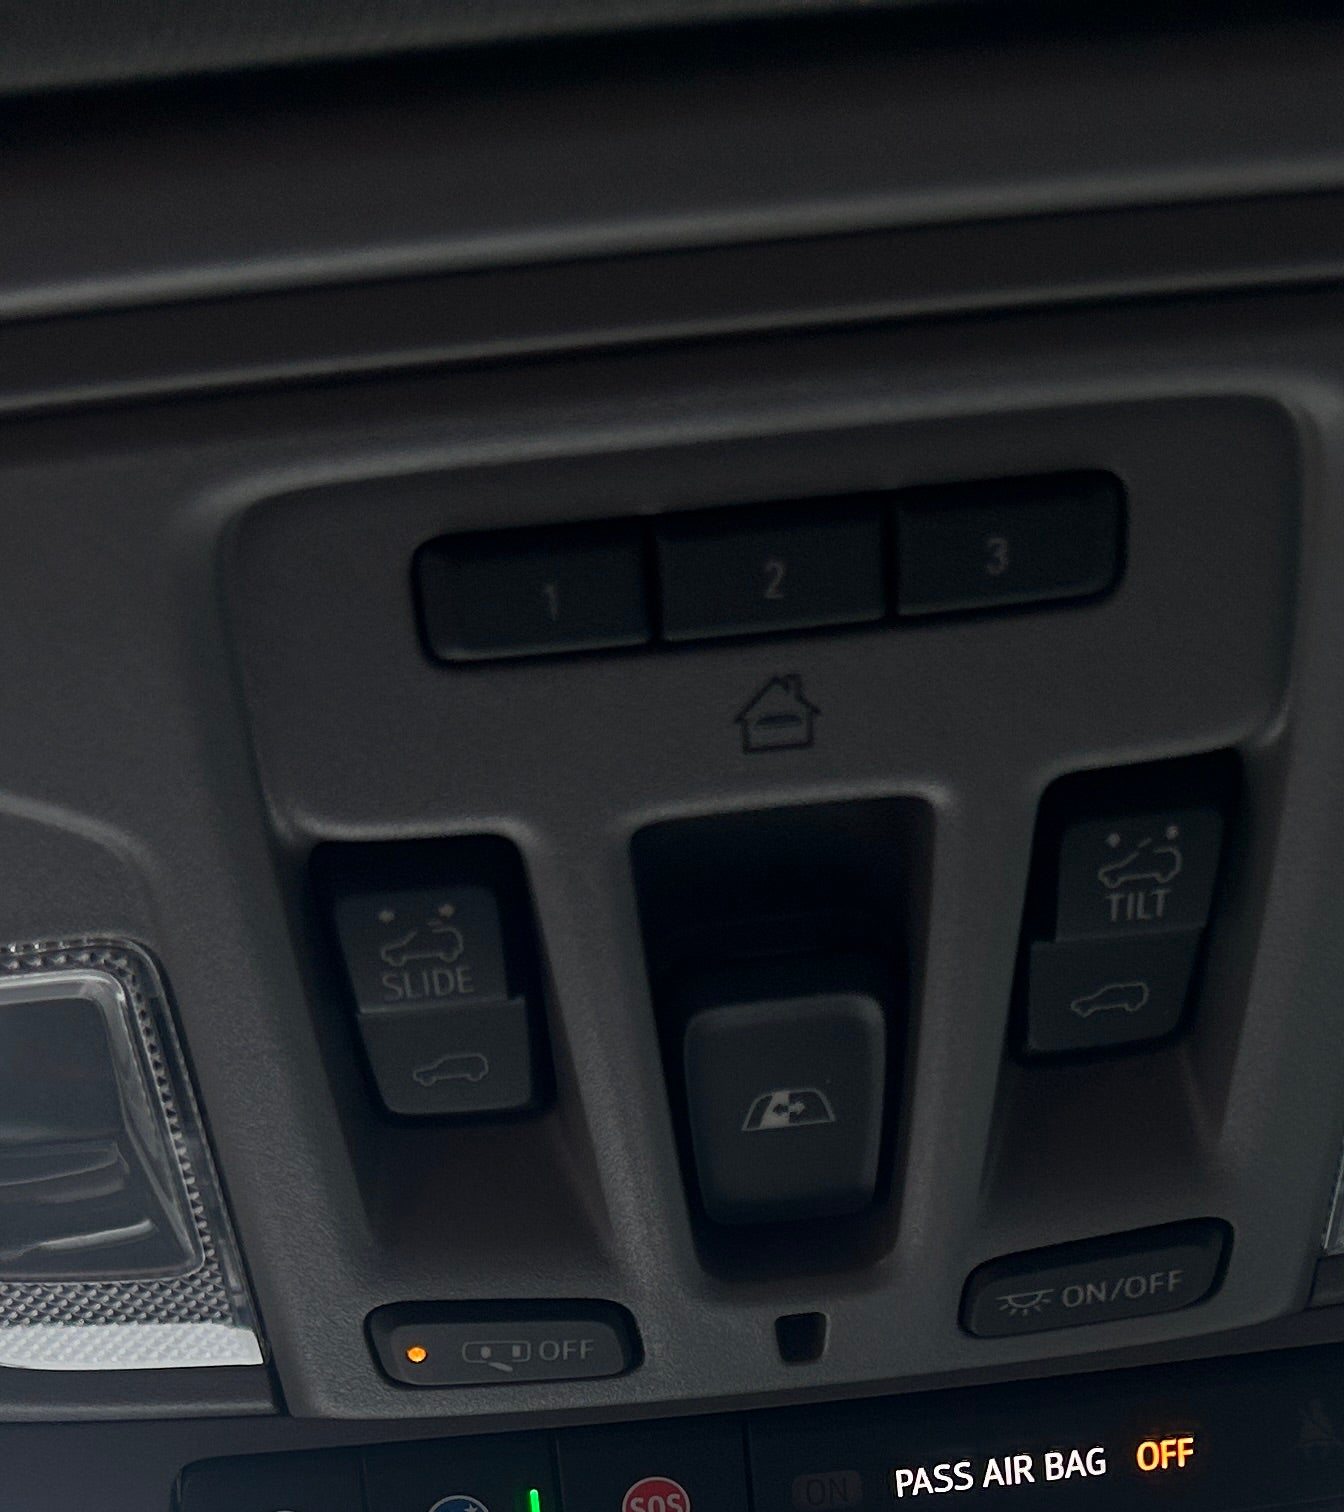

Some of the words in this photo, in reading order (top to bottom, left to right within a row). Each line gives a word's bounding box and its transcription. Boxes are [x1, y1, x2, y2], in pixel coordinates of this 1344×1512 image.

[985, 537, 1008, 575] 3
[765, 560, 787, 600] 2
[1106, 889, 1169, 922] TILT
[382, 965, 474, 1000] SLIDE
[1062, 1270, 1184, 1308] ON/OFF
[538, 1339, 594, 1362] OFF
[896, 1462, 974, 1498] PASS
[983, 1454, 1036, 1487] AIR
[1045, 1447, 1107, 1481] BAG
[1137, 1437, 1194, 1471] OFF
